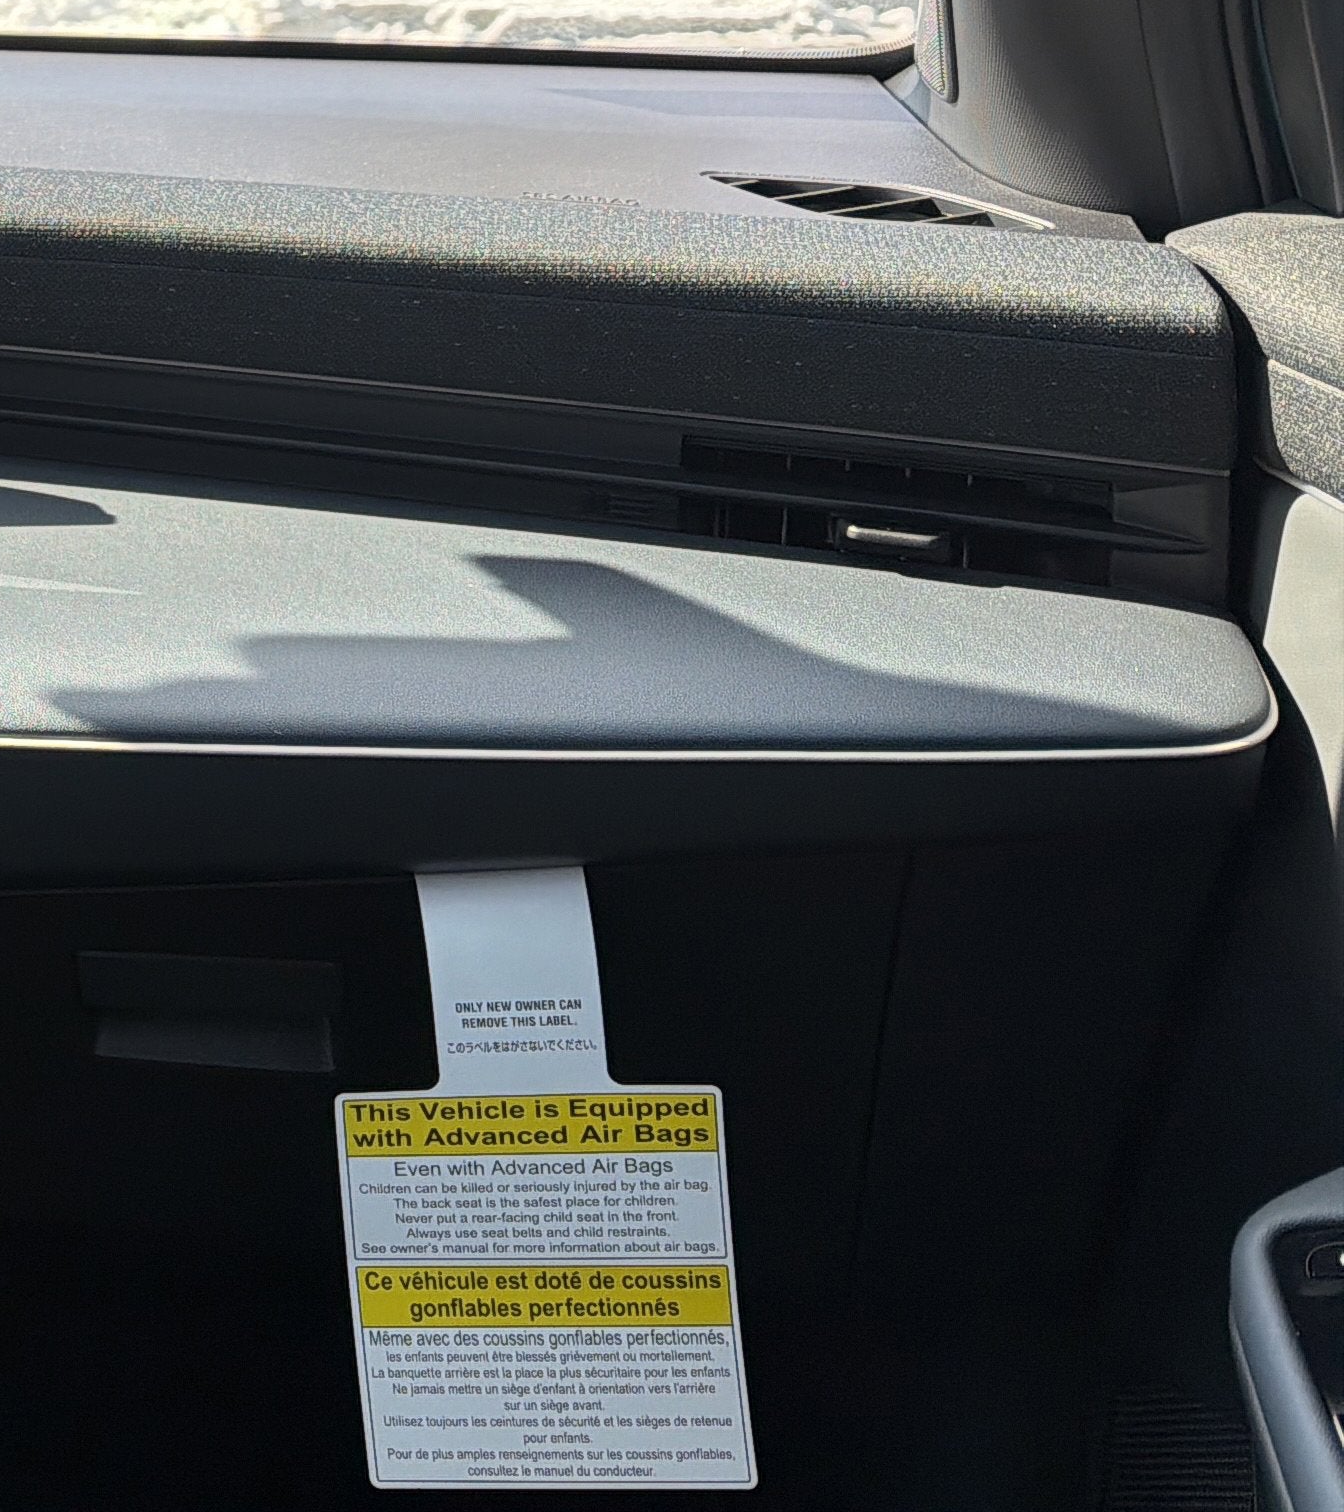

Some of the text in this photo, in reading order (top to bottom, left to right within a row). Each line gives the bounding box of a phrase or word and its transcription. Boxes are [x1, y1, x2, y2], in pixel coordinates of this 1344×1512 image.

[455, 999, 582, 1013] ONLY NEW OWNER CAN
[462, 1017, 508, 1028] REMOVE
[512, 1016, 536, 1027] THIS
[349, 1098, 709, 1122] This Vehicle is Equipped
[353, 1124, 709, 1147] with Advanced Air Bags
[394, 1158, 673, 1176] Even with Advanced Air Bags
[407, 1229, 451, 1241] Always
[455, 1230, 478, 1238] use
[482, 1229, 508, 1238] seat
[512, 1228, 542, 1238] belts
[547, 1227, 570, 1237] and
[574, 1227, 603, 1237] child
[362, 1244, 386, 1253] See
[390, 1243, 438, 1253] owner's
[443, 1243, 488, 1253] manual
[492, 1242, 509, 1252] for
[513, 1244, 545, 1252] more
[550, 1242, 620, 1252] information
[625, 1242, 660, 1252] about
[664, 1241, 680, 1251] air
[365, 1271, 721, 1290] Ce véhicule est doté de coussins
[410, 1298, 680, 1322] gonflables perfectionnés
[369, 1330, 729, 1349] Même avec des coussins gonflables perfectionnés,
[392, 1382, 715, 1397] Ne jamais mettre un siège d'enfant à orientation vers l'arrière
[468, 1465, 518, 1476] consultez
[521, 1465, 531, 1476] le
[535, 1465, 574, 1476] manuel
[577, 1465, 590, 1476] du
